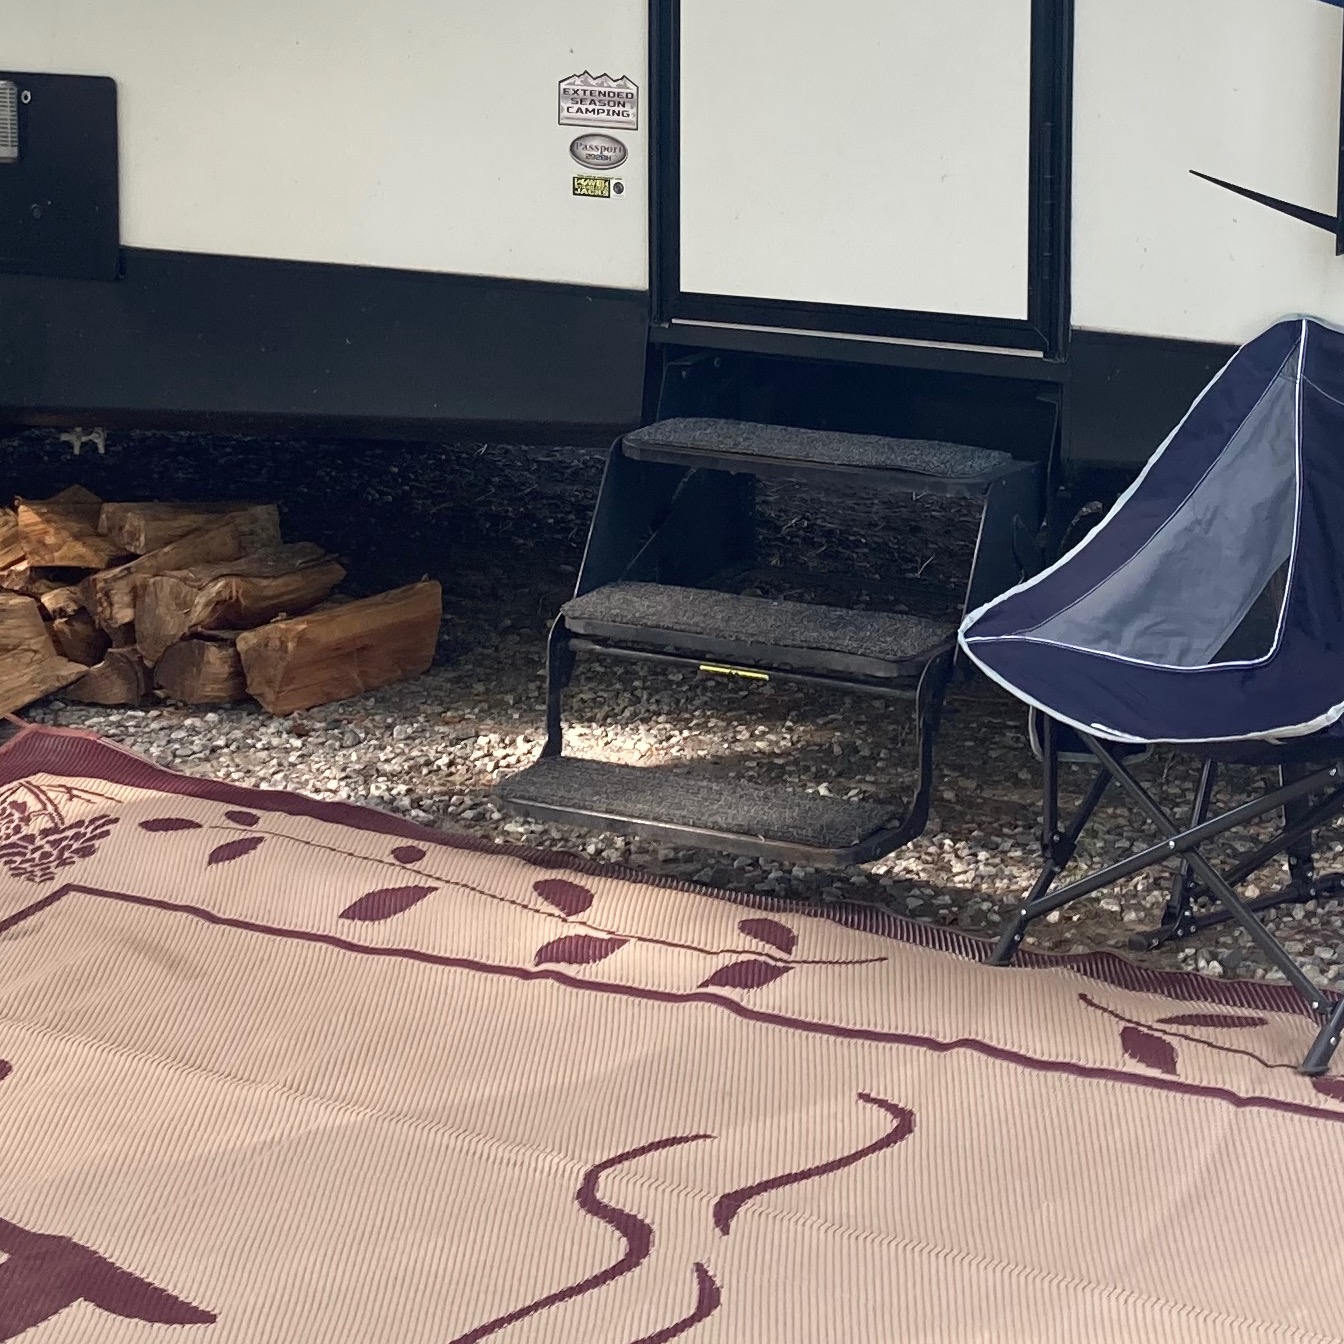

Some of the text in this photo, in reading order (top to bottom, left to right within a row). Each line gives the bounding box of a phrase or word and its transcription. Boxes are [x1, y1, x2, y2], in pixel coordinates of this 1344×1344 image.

[562, 87, 634, 100] EXTENDED
[570, 97, 626, 108] SEASON
[566, 106, 631, 118] CAMPING
[575, 141, 623, 155] Passport
